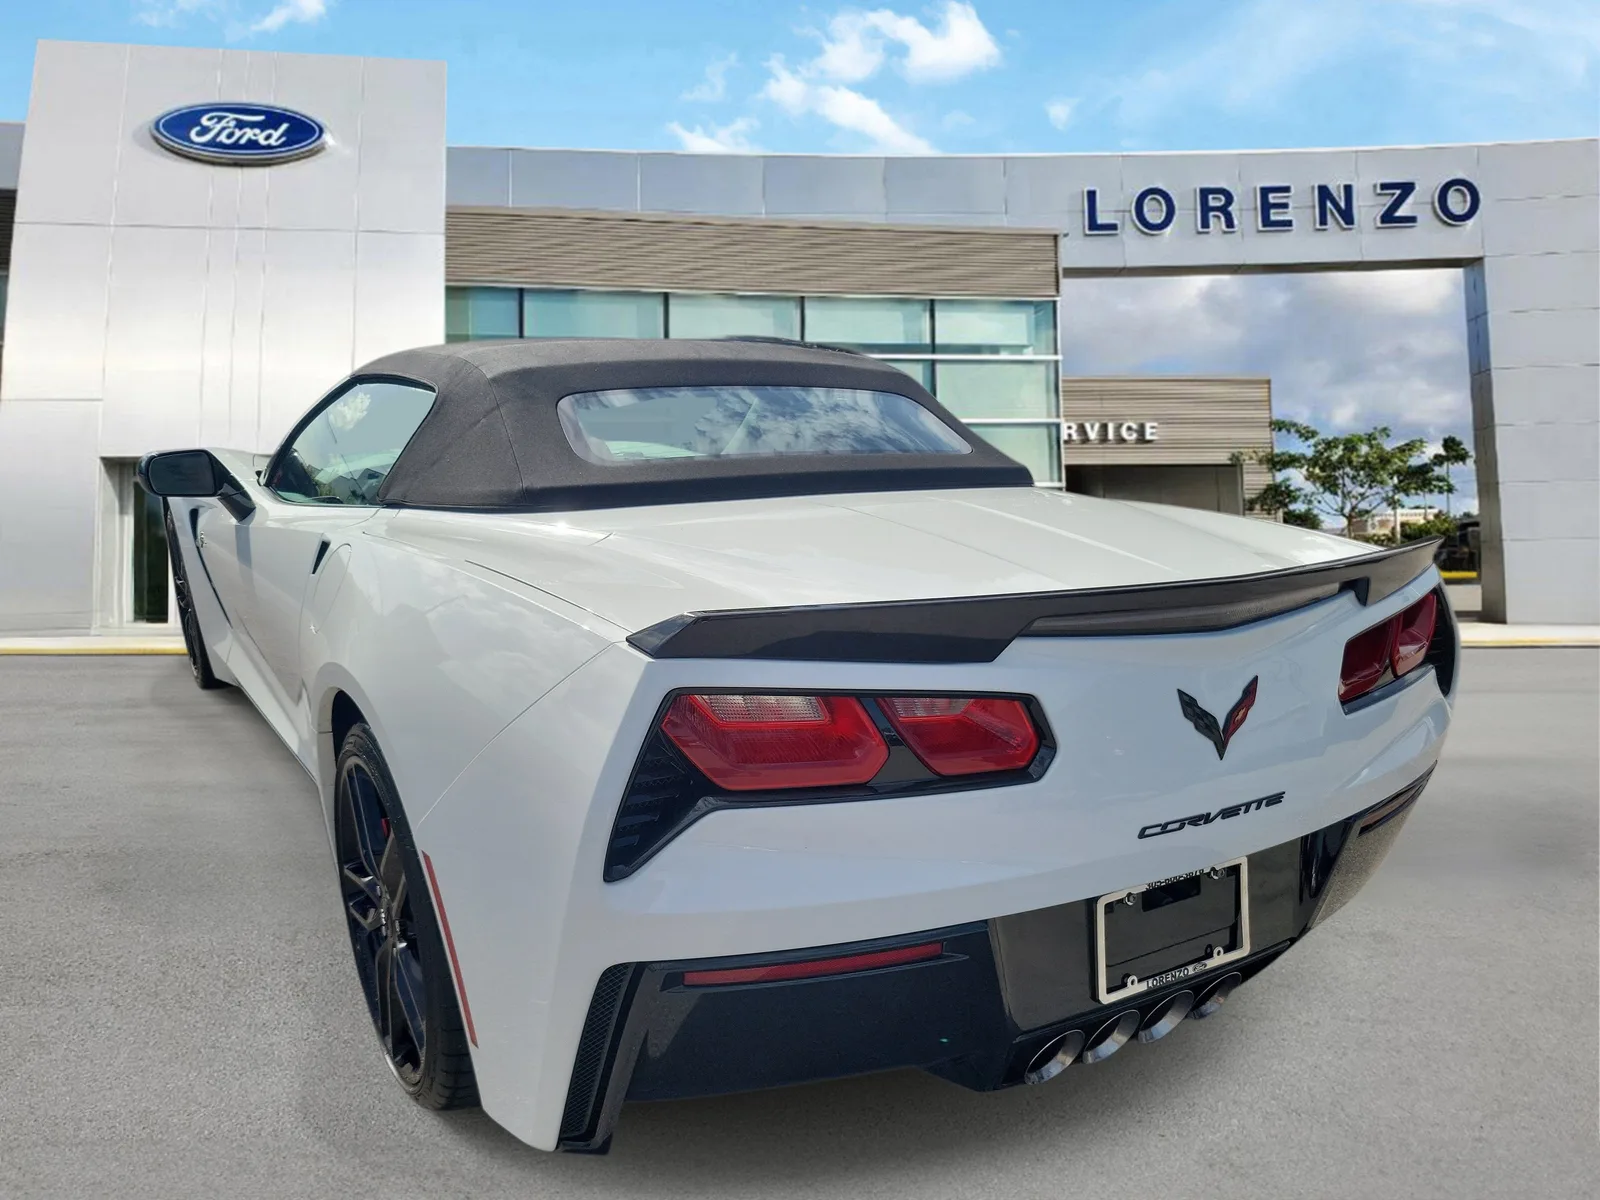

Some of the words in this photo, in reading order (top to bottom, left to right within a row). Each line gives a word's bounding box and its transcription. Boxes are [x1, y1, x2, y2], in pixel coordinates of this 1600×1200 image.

[189, 112, 290, 146] Ford
[1083, 177, 1481, 236] LORENZO
[1138, 791, 1286, 839] CORVETTE
[1146, 967, 1190, 989] LORENZO
